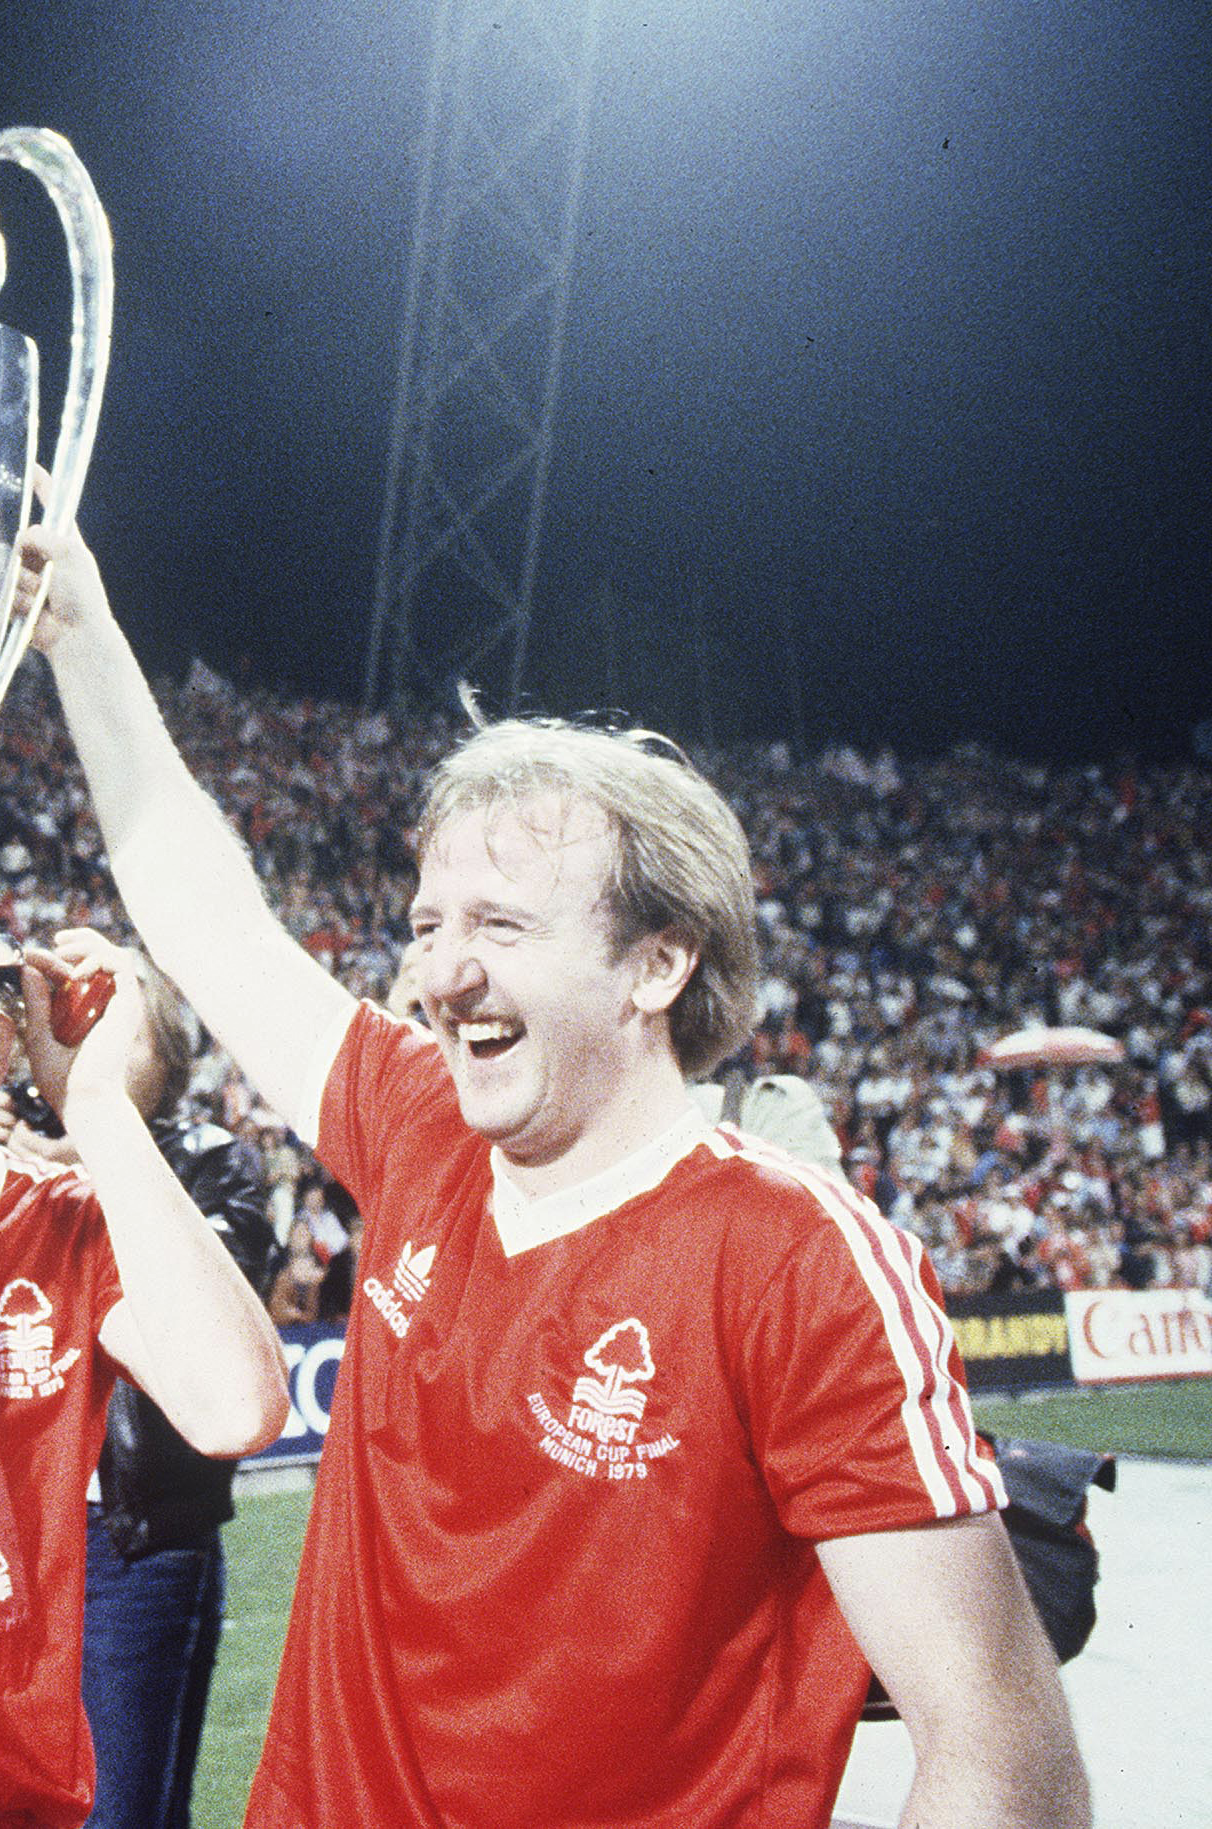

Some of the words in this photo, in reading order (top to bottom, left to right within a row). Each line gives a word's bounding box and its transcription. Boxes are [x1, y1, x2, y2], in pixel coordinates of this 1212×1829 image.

[363, 1277, 412, 1338] adidas
[527, 1392, 592, 1457] EUROPEAN
[597, 1444, 629, 1463] CUP
[636, 1433, 680, 1460] FINAL
[539, 1435, 597, 1477] MUNICH
[608, 1462, 648, 1480] 1979
